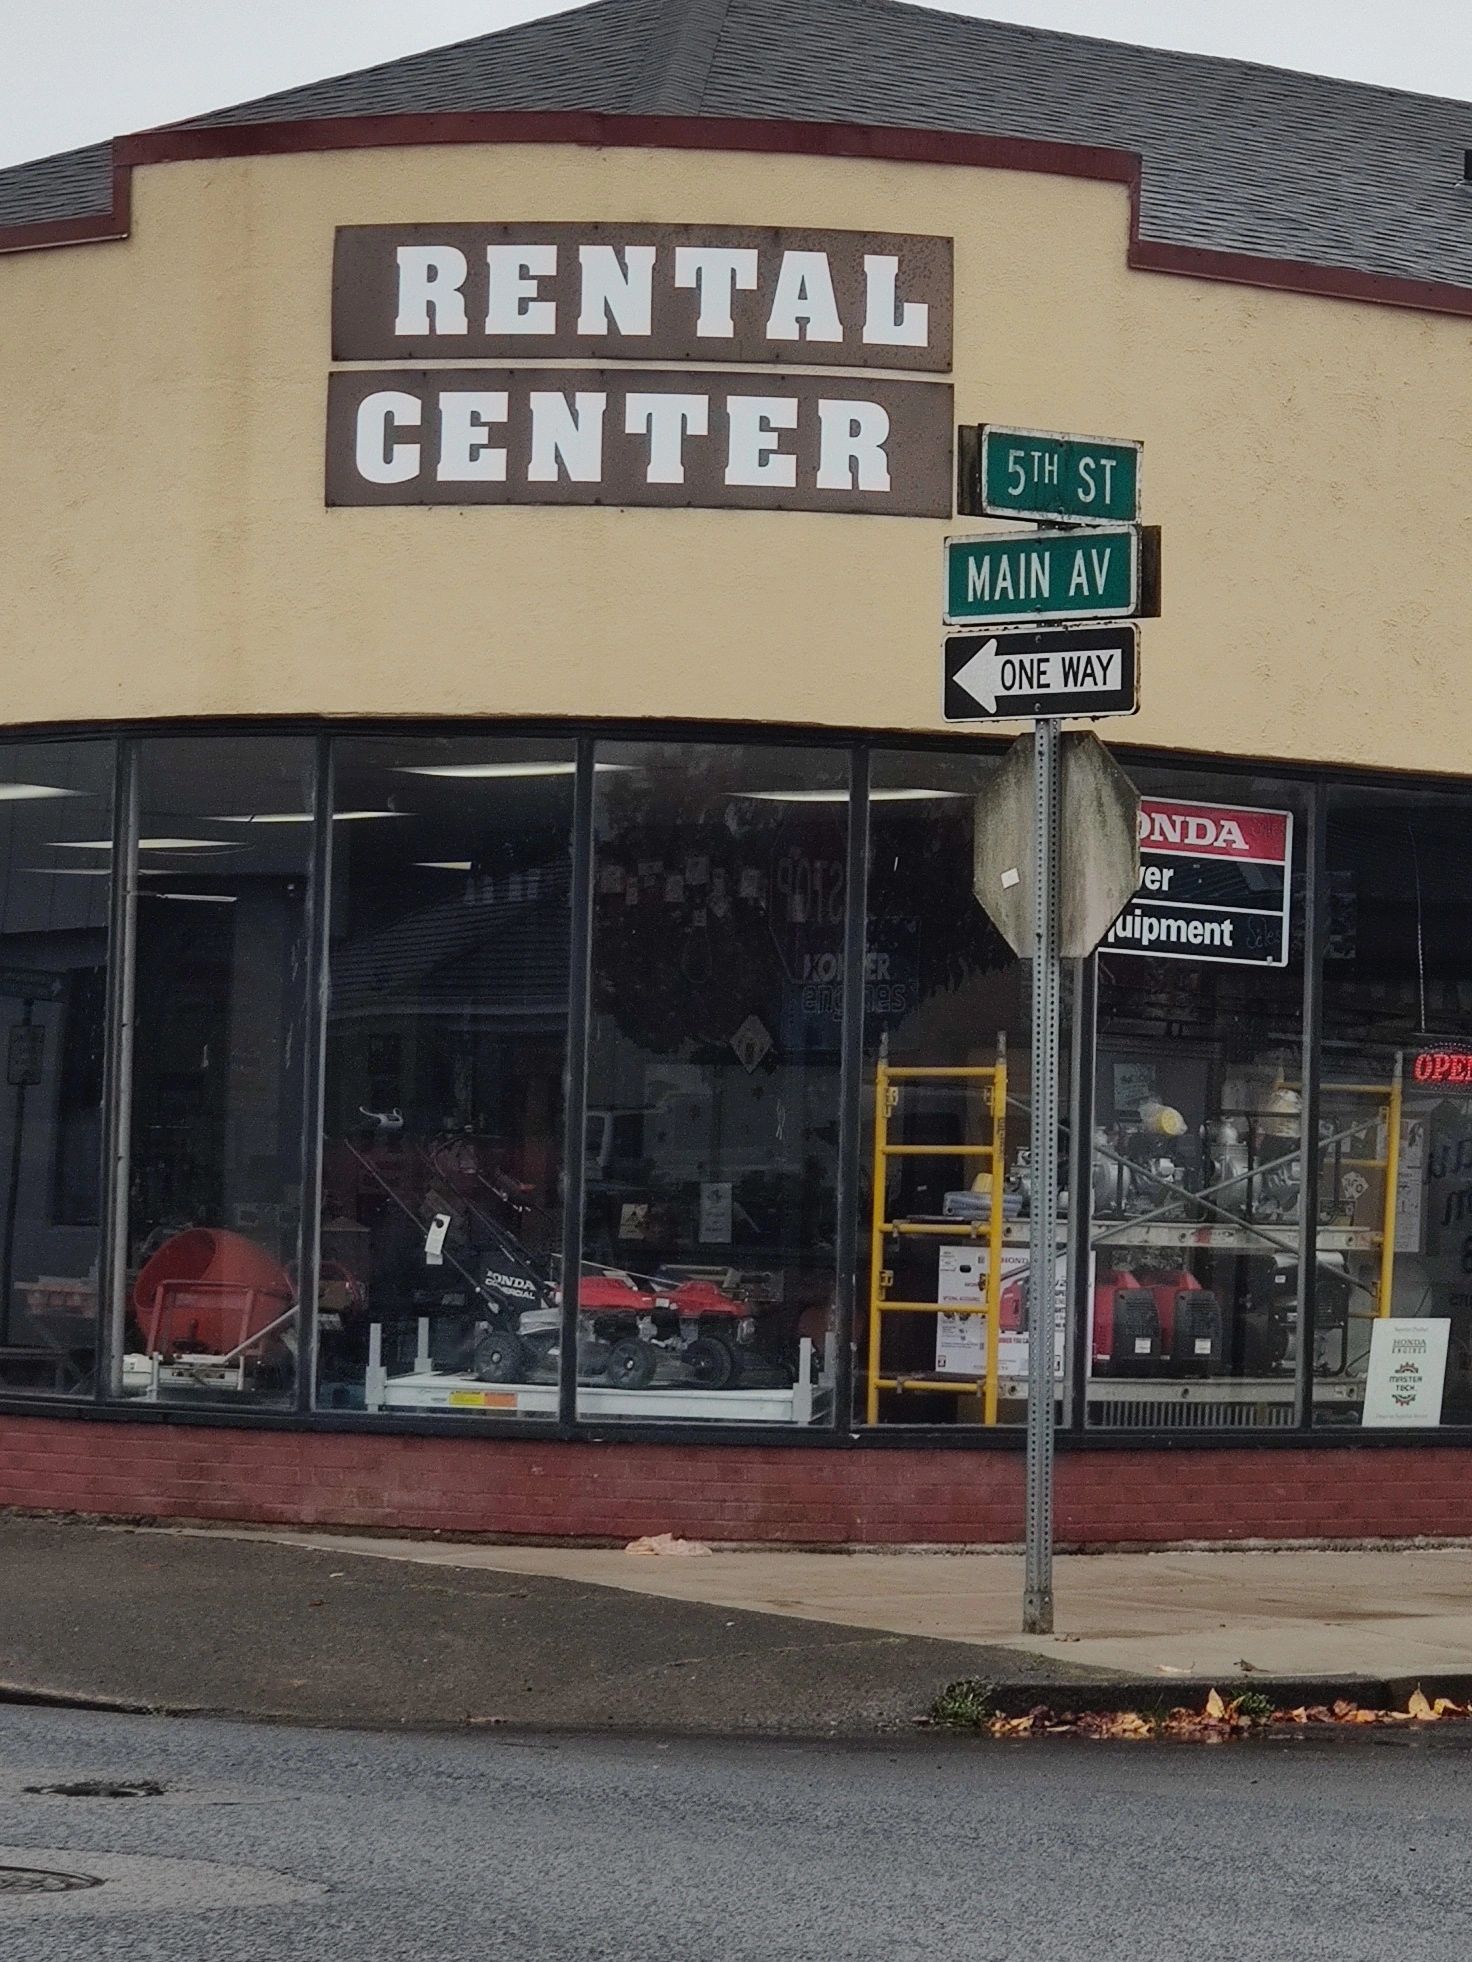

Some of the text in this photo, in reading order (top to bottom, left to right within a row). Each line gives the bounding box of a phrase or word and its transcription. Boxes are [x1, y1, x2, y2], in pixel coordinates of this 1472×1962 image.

[394, 244, 929, 347] RENTAL
[355, 390, 892, 492] CENTER
[1007, 448, 1117, 505] 5TH ST
[967, 547, 1112, 603] MAIN AV
[1000, 653, 1115, 691] ONE WAY
[1137, 811, 1250, 850] NDA
[1107, 908, 1234, 947] uipment
[801, 984, 907, 1023] engnes
